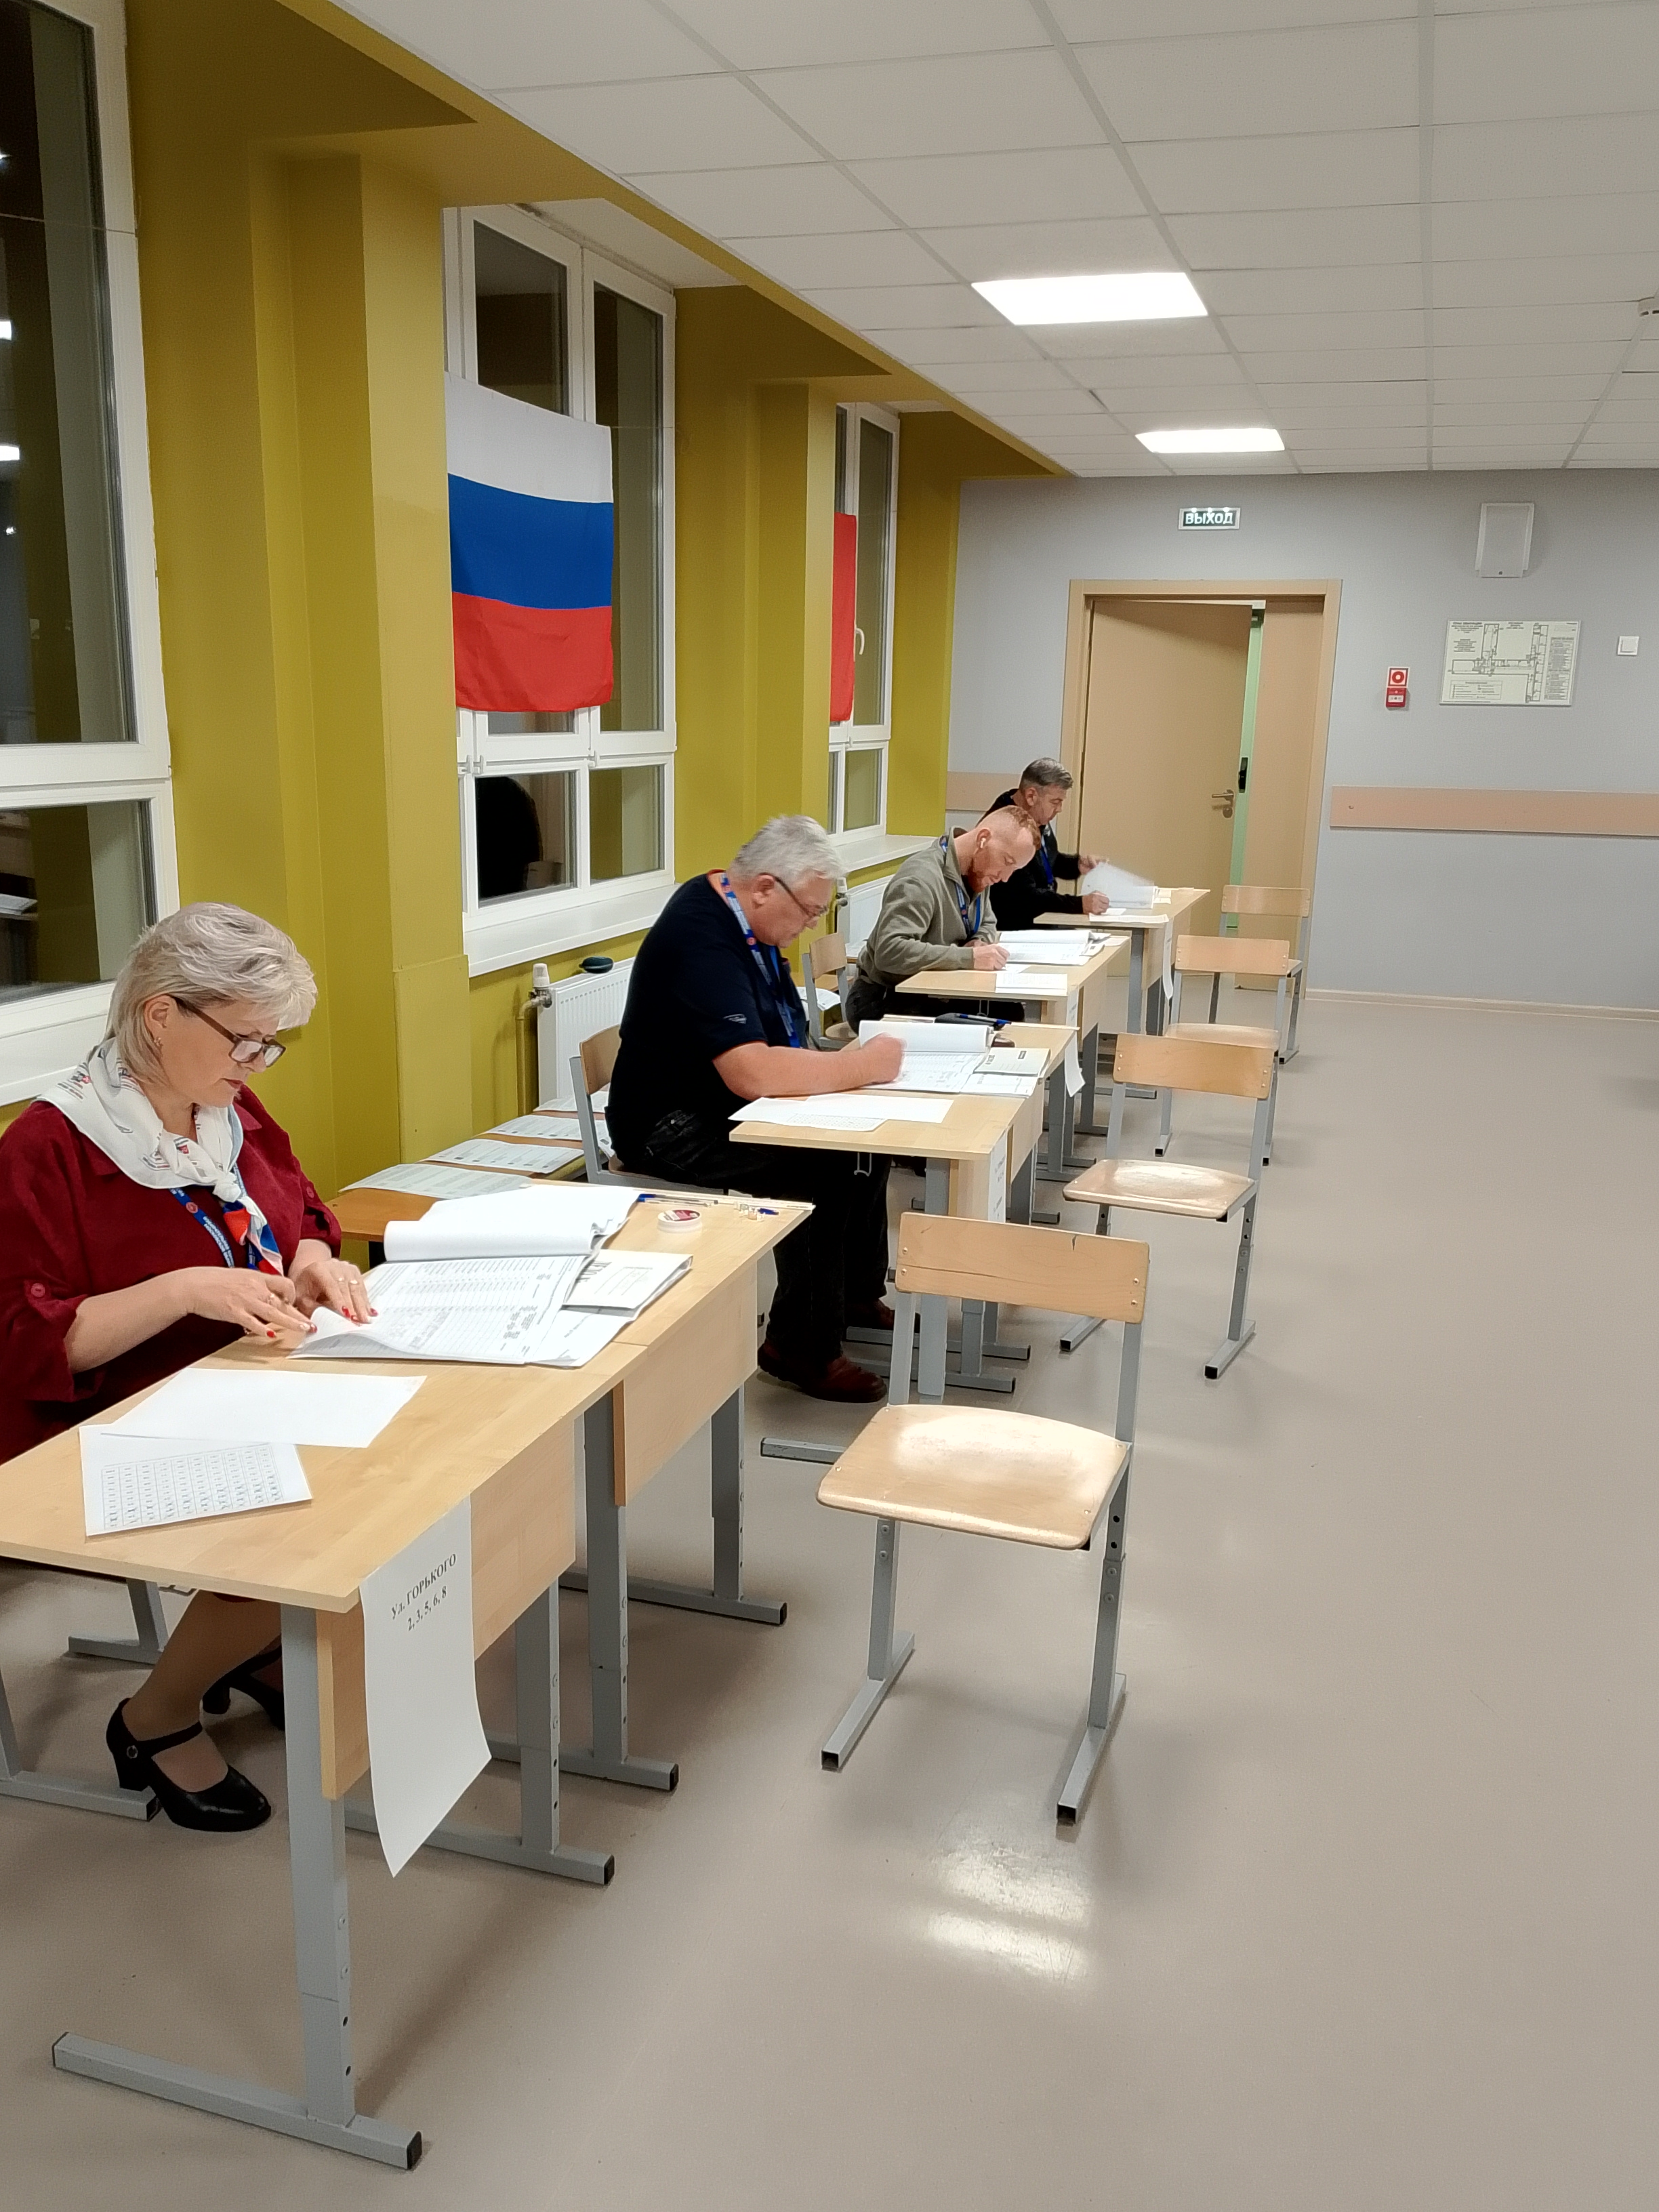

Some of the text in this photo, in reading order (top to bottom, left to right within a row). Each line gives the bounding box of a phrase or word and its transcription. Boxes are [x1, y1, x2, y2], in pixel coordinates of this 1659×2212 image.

[1185, 512, 1233, 525] ВЫХОД
[392, 1553, 456, 1620] Ул. ГОРЬКОГО
[442, 1585, 447, 1599] 8
